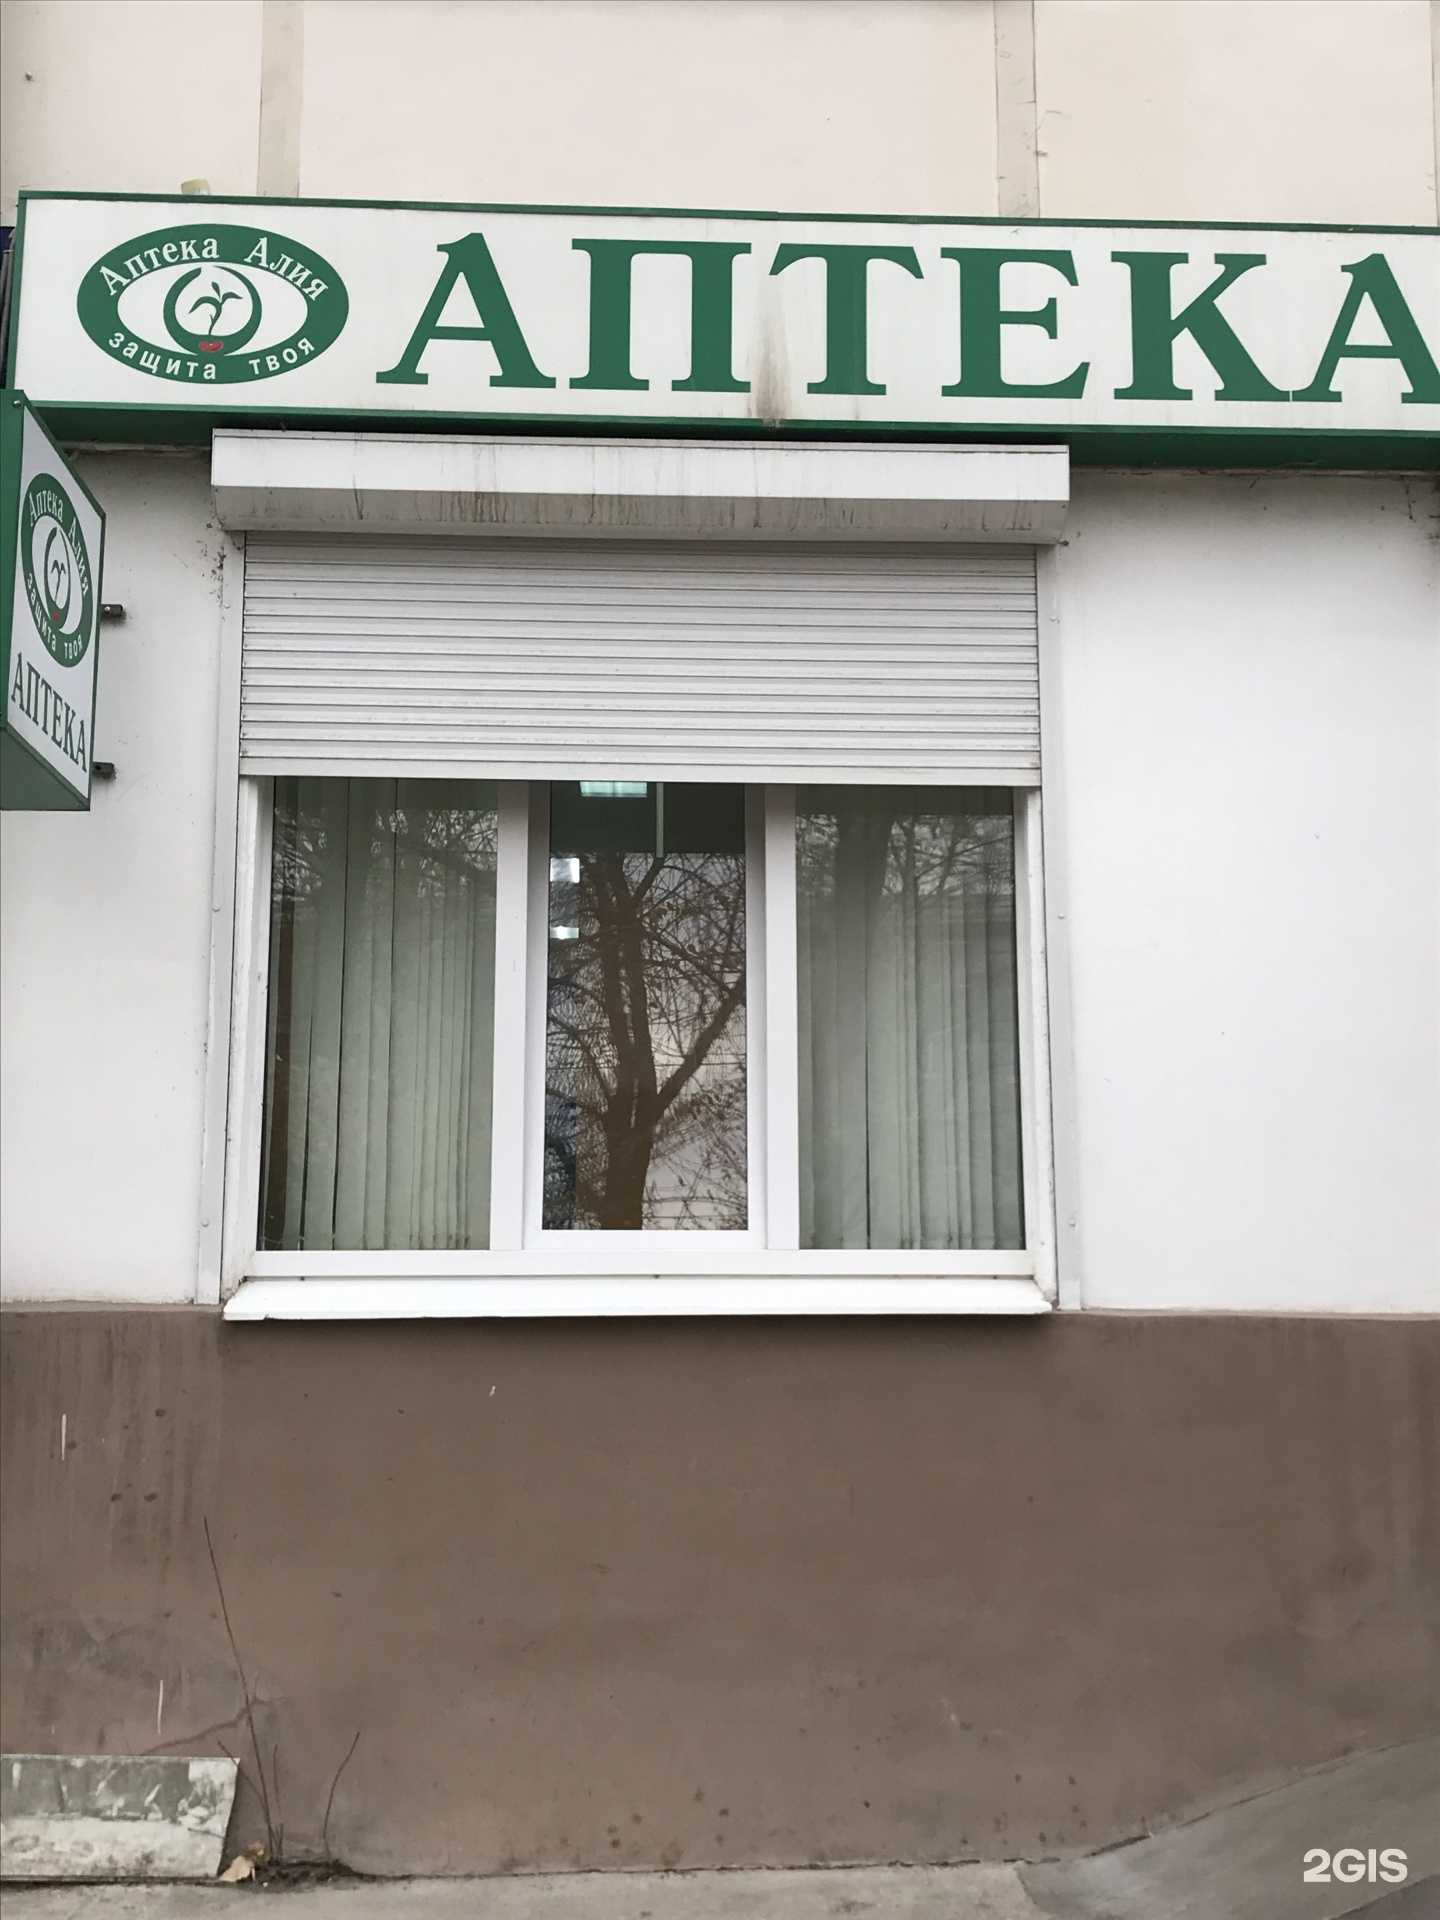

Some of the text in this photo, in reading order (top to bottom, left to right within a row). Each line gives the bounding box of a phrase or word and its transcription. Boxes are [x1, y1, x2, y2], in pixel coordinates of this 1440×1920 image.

[99, 236, 329, 301] Аптека Алия
[108, 332, 315, 380] защита твоя
[376, 232, 1440, 405] АПТЕКА
[28, 489, 89, 599] Аптека Алия
[27, 572, 83, 660] защита твоя
[11, 652, 87, 773] АПТЕКА
